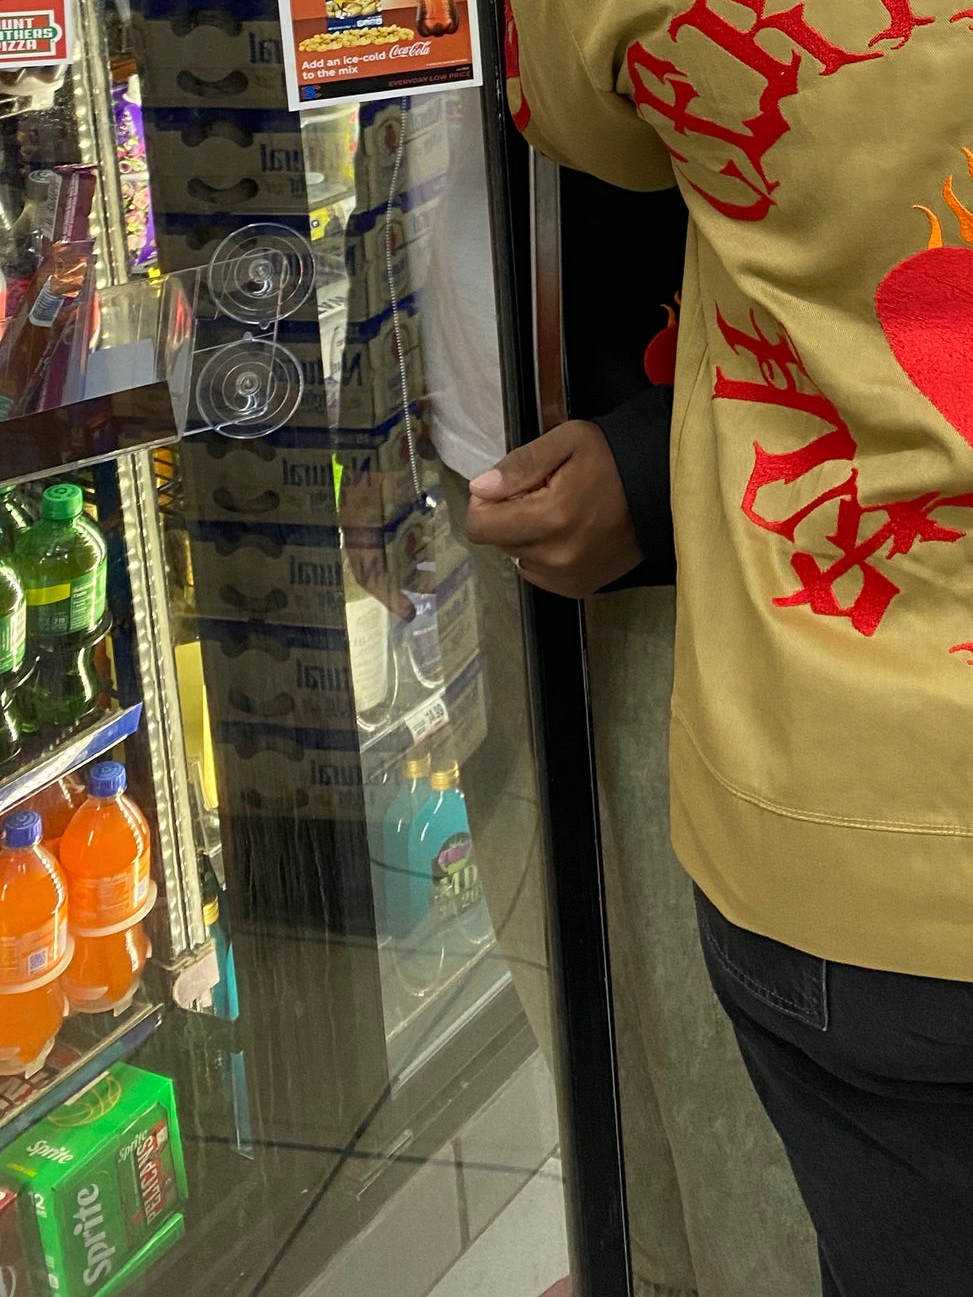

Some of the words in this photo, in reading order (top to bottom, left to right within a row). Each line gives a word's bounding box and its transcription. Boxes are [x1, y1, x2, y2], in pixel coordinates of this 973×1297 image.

[0, 27, 53, 42] THERS
[0, 39, 37, 53] IZZA
[301, 57, 325, 71] Add
[327, 57, 341, 67] an
[343, 51, 386, 65] ice-cold
[302, 69, 315, 80] to
[317, 67, 335, 78] the
[338, 64, 358, 75] mix
[388, 76, 429, 88] EVERYDAY
[429, 74, 448, 83] LOW
[26, 1140, 74, 1164] Sprite
[118, 1129, 148, 1163] Sprite
[72, 1183, 116, 1286] Sprite
